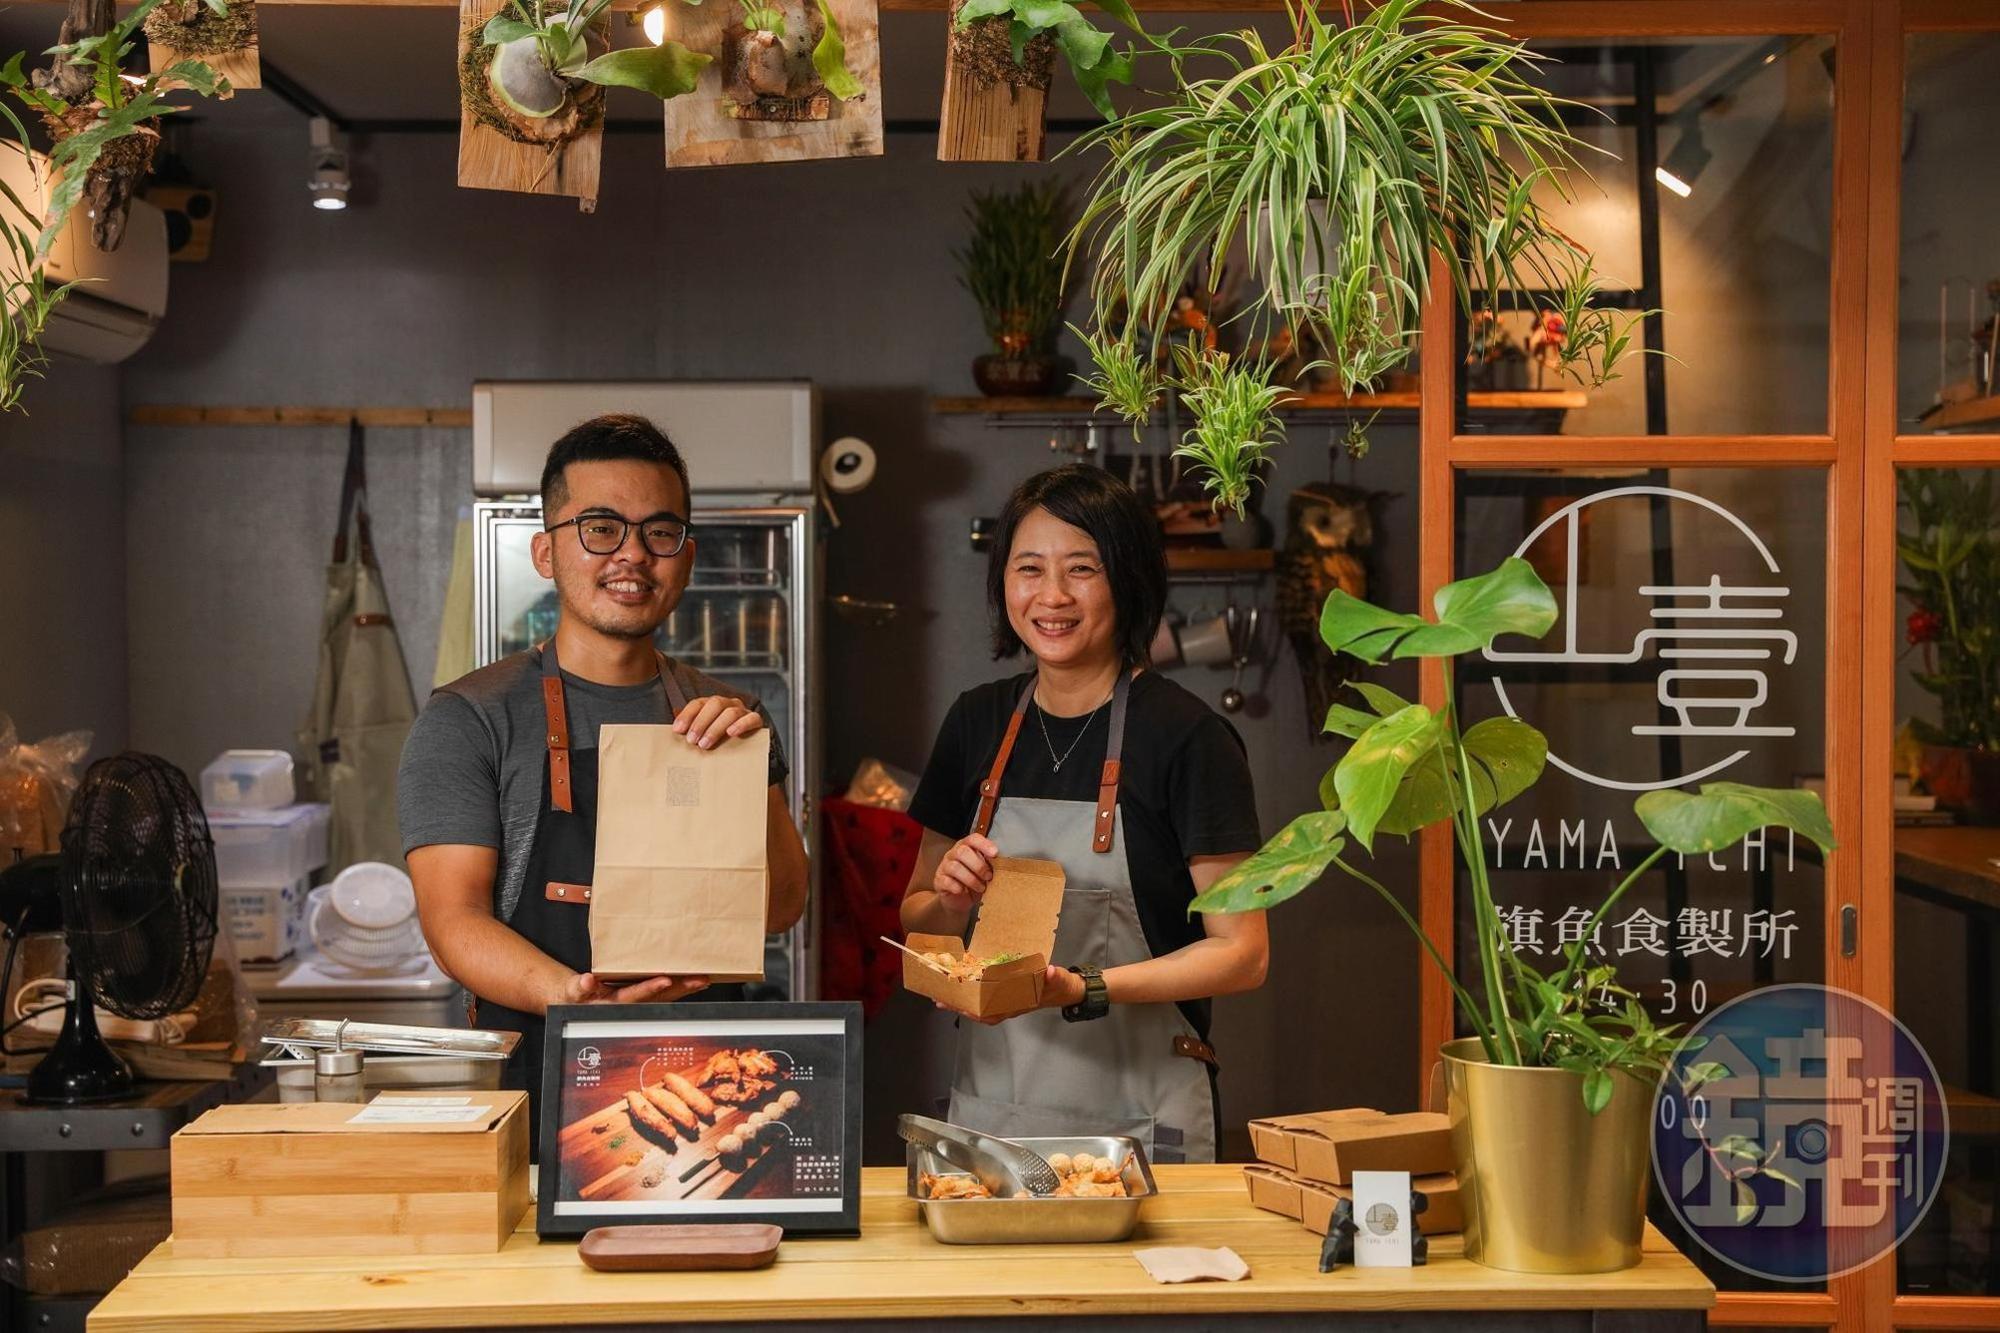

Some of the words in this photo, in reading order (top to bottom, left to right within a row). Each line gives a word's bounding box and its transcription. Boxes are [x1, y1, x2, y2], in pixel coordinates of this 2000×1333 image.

[1487, 817, 1621, 870] YAMA
[1494, 905, 1800, 960] 旗魚食製所
